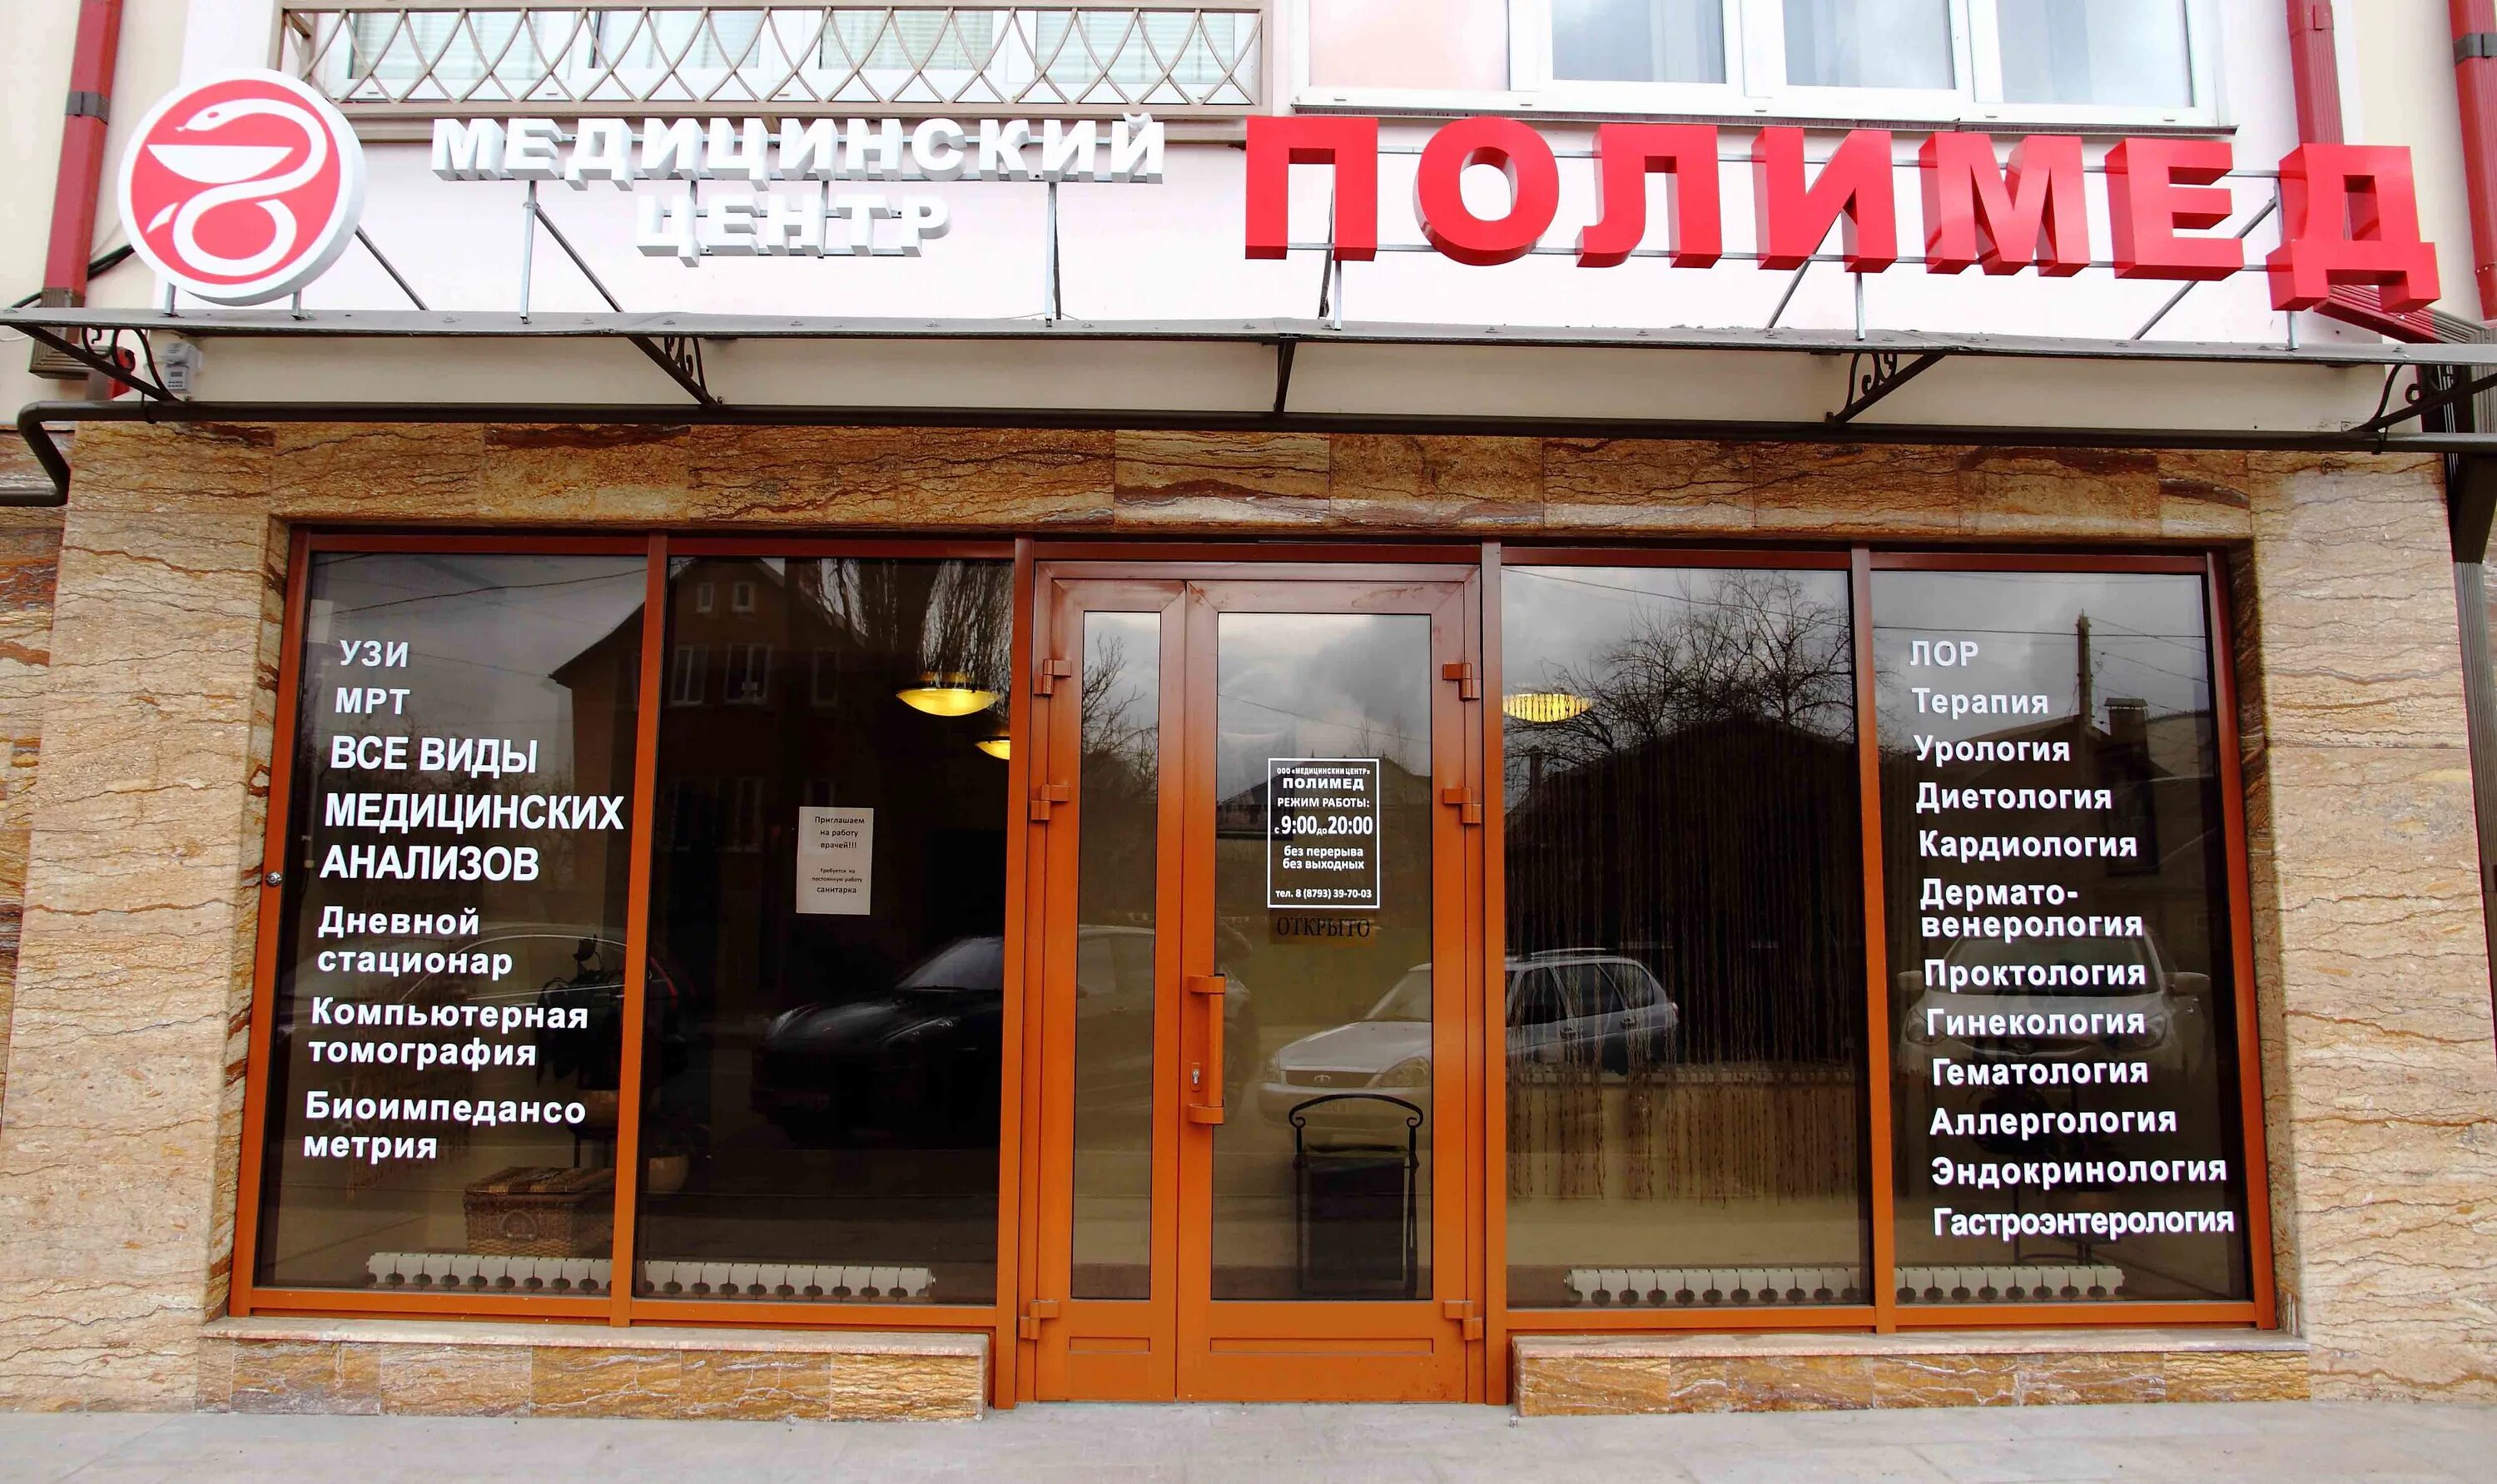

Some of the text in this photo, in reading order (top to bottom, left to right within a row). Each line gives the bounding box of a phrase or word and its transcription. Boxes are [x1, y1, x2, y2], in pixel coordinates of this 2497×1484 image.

[431, 112, 1166, 191] МЕДИЦИНСКИЙ
[1244, 114, 2441, 312] ПОЛИМЕД
[636, 193, 952, 267] ЦЕНТР
[340, 639, 409, 668] УЗИ
[1909, 640, 1979, 667] ЛОР
[335, 687, 410, 715] МРТ
[1911, 687, 2049, 720] Терапия
[330, 735, 538, 779] ВСЕ ВИДЫ
[1914, 734, 2070, 767] Урология
[1283, 777, 1364, 792] ПОЛИМЕД
[1346, 767, 1371, 776] ЦЕНТР»
[325, 792, 625, 835] МЕДИЦИНСКИХ
[1277, 797, 1370, 808] РЕЖИМ РАБОТЫ:
[1915, 782, 2112, 814] Диетология
[814, 816, 865, 825] Приглашаем
[832, 829, 859, 837] работу
[1274, 816, 1373, 836] с 9:00 до 20:00
[820, 841, 857, 850] врачей!!!
[1283, 845, 1364, 858] без перерыва
[1919, 830, 2137, 863] Кардиология
[320, 844, 539, 881] АНАЛИЗОВ
[1283, 857, 1365, 871] без выходных
[817, 886, 857, 894] санитарка
[1275, 888, 1373, 900] тел. 8 (8793) 39-70-03
[1920, 877, 2078, 912] Дермато-
[317, 905, 479, 938] Дневной
[1276, 916, 1371, 938] ОТКРЫТО
[1921, 915, 2143, 944] венерология
[317, 950, 514, 980] стационар
[1924, 958, 2147, 993] Проктология
[311, 996, 588, 1034] Компьютерная
[1927, 1008, 2146, 1036] Гинекология
[308, 1037, 537, 1071] томография
[1932, 1058, 2148, 1086] Гематология
[305, 1090, 586, 1126] Биоимпедансо
[1929, 1107, 2177, 1141] Аллергология
[303, 1134, 438, 1165] метрия
[1931, 1156, 2227, 1189] Эндокринология
[1933, 1207, 2235, 1241] Гастроэнтерология
